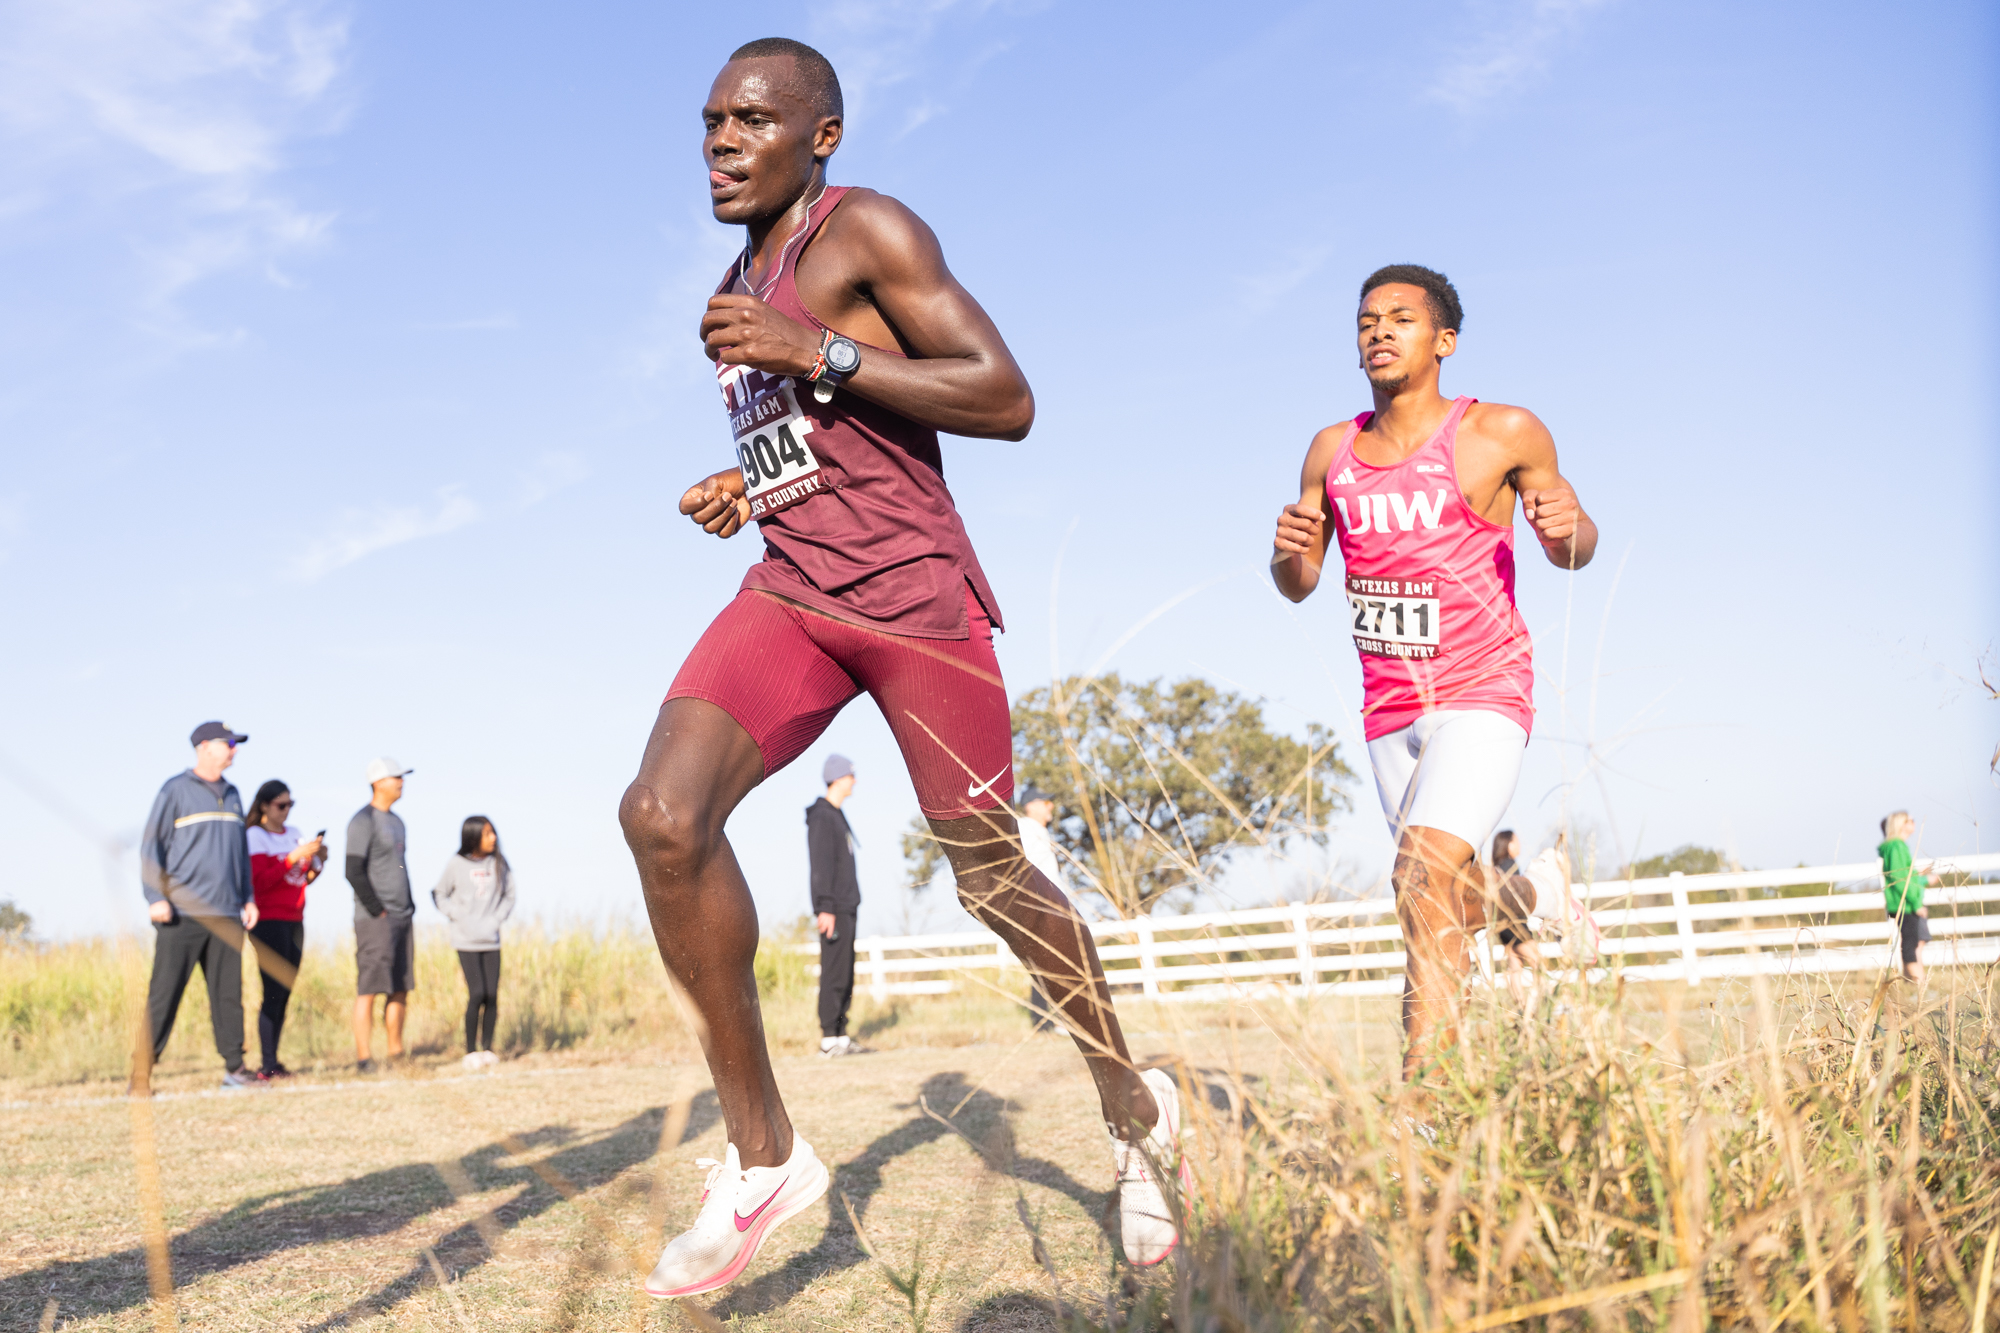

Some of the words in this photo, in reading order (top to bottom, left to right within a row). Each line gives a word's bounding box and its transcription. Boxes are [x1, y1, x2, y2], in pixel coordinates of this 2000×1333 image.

[755, 396, 782, 421] A&M
[766, 475, 820, 508] COUNTRY
[1334, 489, 1447, 535] UIW
[1360, 579, 1399, 595] TEXAS
[1404, 581, 1434, 595] A&M
[1352, 598, 1429, 637] 2711
[1356, 638, 1383, 653] CROSS
[1384, 643, 1435, 657] COUNTRY
